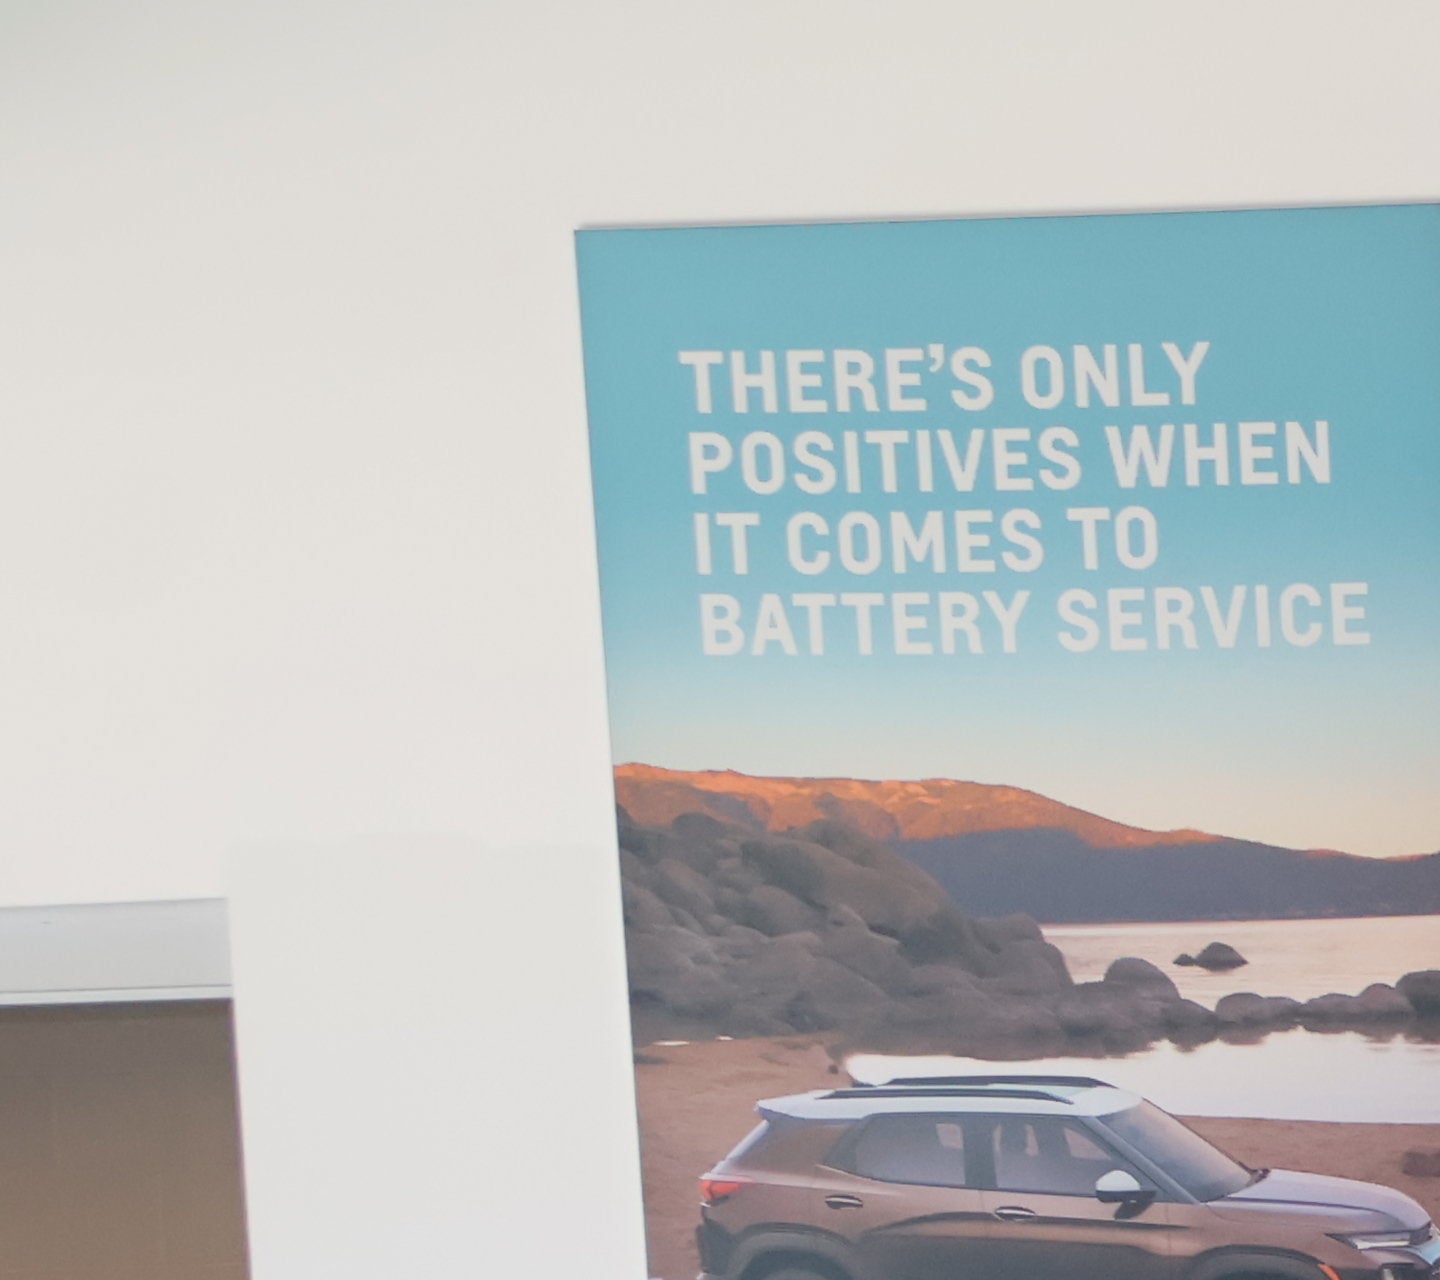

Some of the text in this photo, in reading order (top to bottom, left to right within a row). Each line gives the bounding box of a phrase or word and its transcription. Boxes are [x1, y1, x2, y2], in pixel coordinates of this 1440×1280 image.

[678, 341, 1210, 414] THERE'S ONLY
[688, 420, 1331, 495] POSITIVES WHEN
[693, 505, 1159, 575] IT COMES TO
[699, 583, 1371, 657] BATTERY SERVICE
